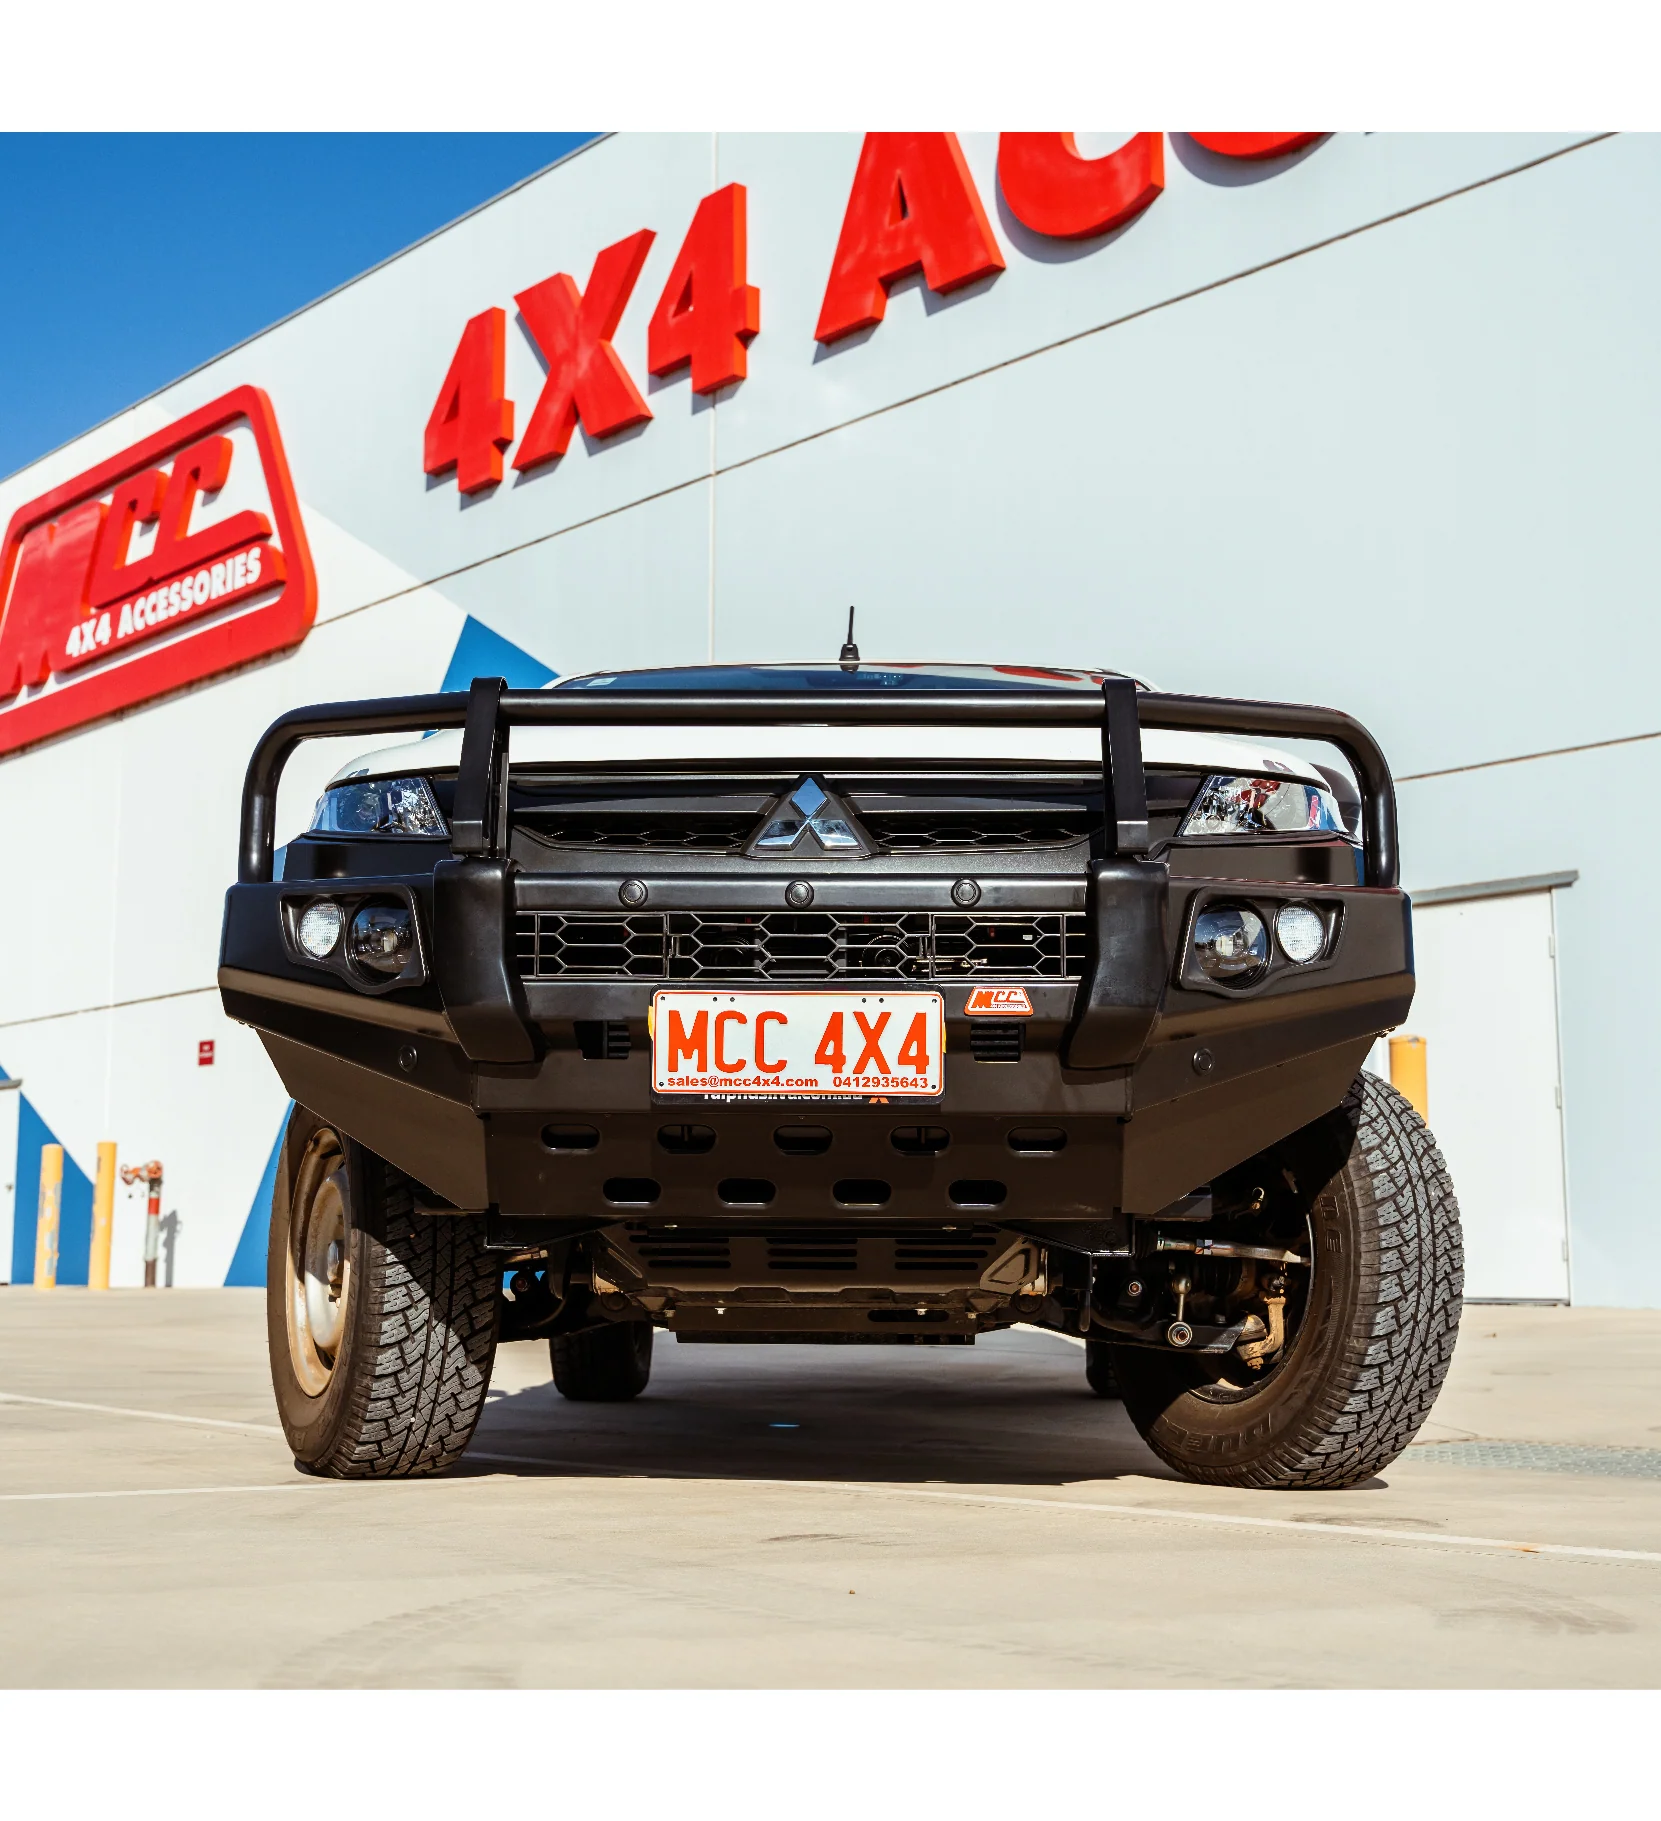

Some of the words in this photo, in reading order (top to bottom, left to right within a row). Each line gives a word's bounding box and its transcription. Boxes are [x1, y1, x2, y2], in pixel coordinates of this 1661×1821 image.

[424, 182, 760, 495] 4X4
[0, 435, 272, 697] MCC
[65, 612, 111, 657] 4X4
[117, 547, 261, 638] ACCESSORIES
[667, 1010, 788, 1073] MCC
[814, 1011, 929, 1075] 4X4
[971, 991, 1025, 1008] MCC
[667, 1075, 819, 1089] sales@mcc4x4.com
[832, 1076, 929, 1089] 0412935643
